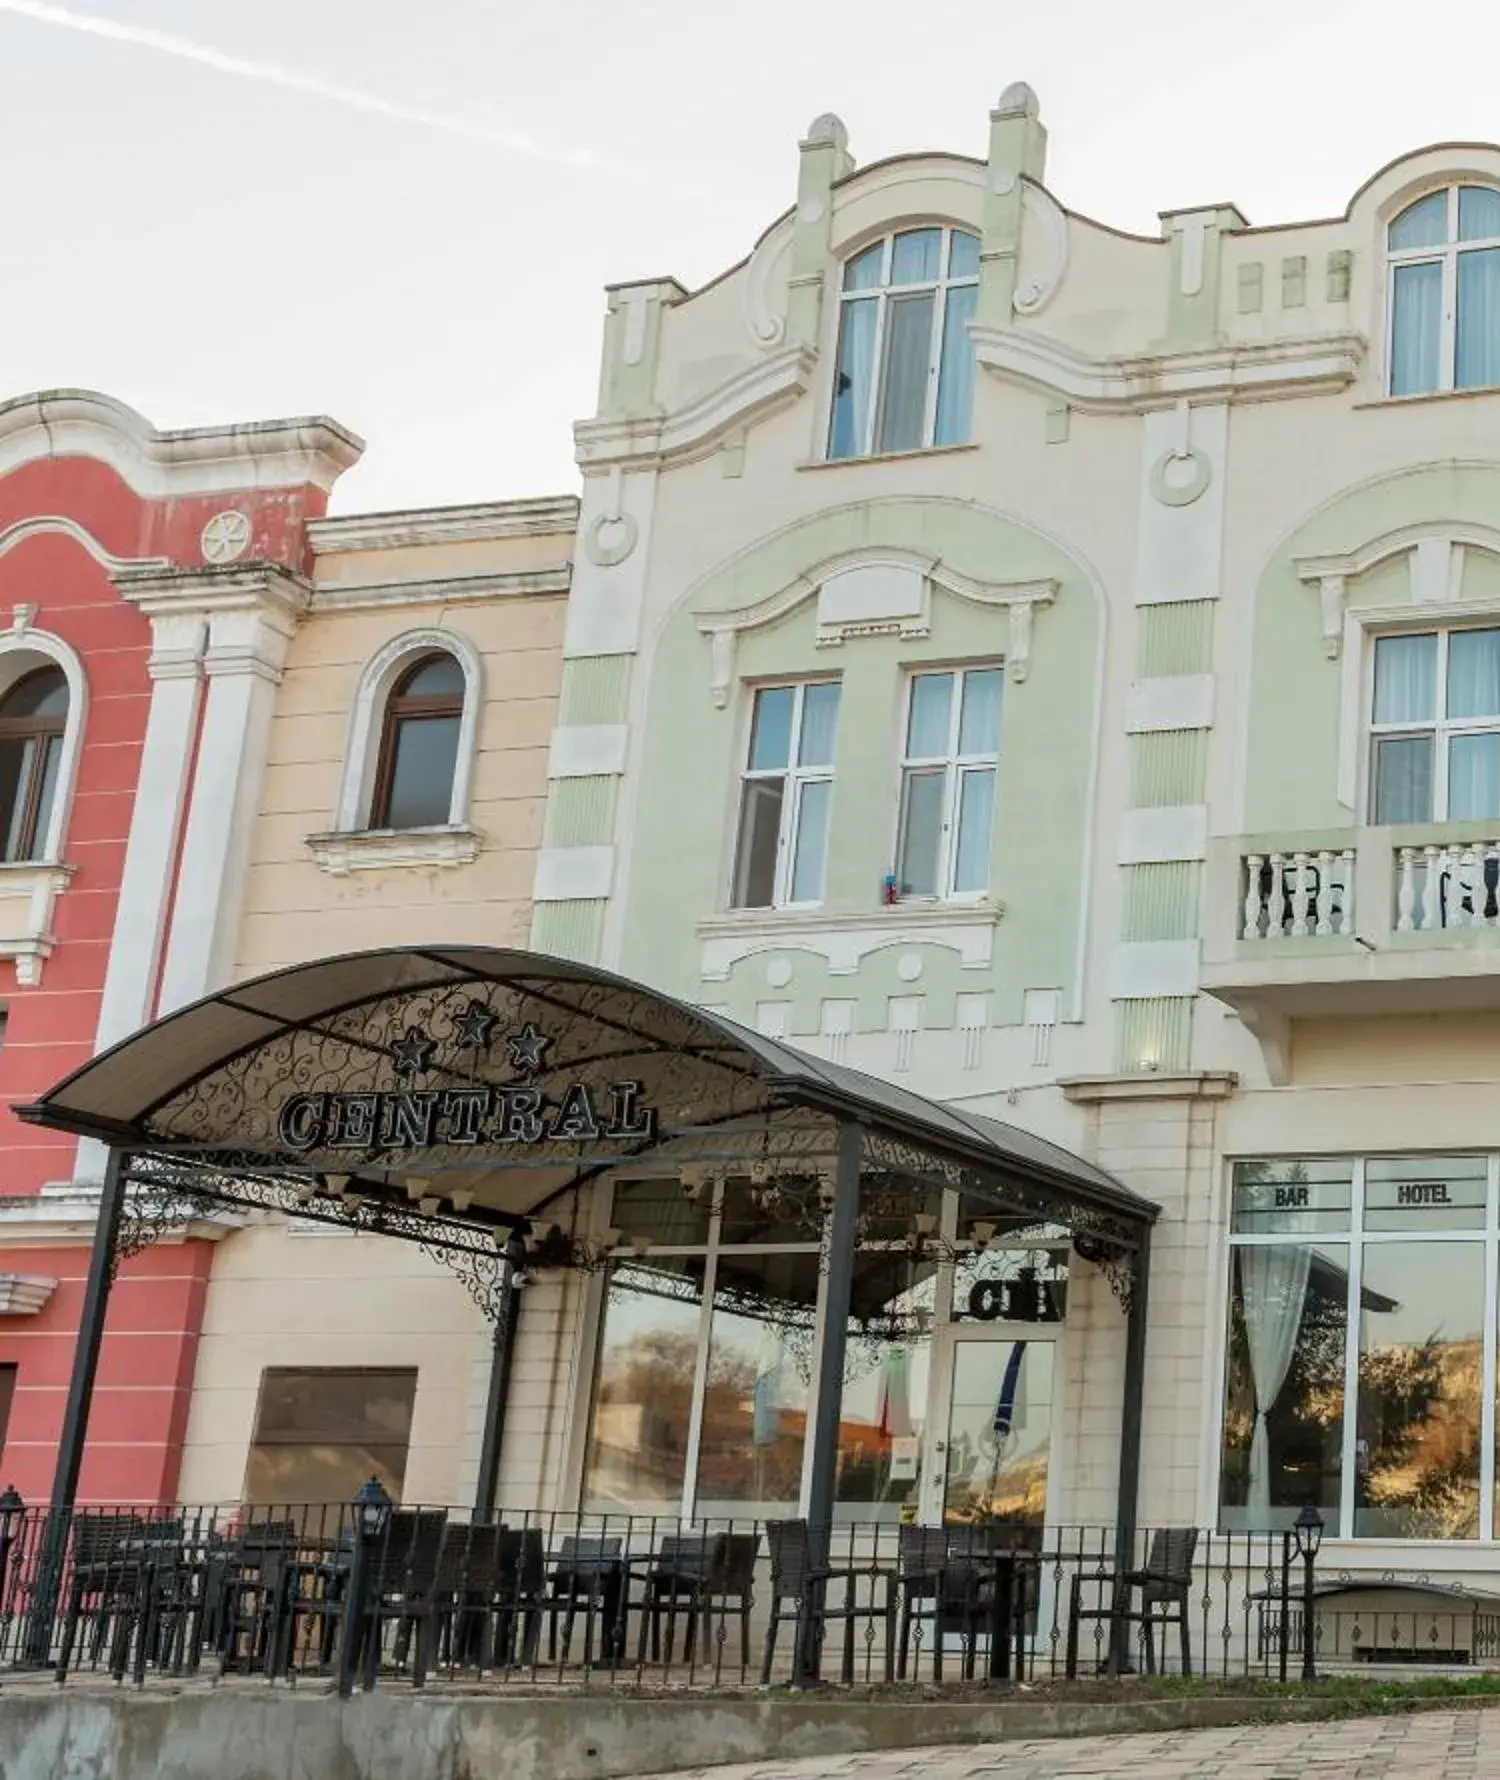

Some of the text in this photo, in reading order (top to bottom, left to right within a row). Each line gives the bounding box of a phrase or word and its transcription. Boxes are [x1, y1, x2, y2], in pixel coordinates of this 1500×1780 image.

[278, 1080, 656, 1149] CENTRAL
[1275, 1184, 1451, 1206] BAR HOTEL
